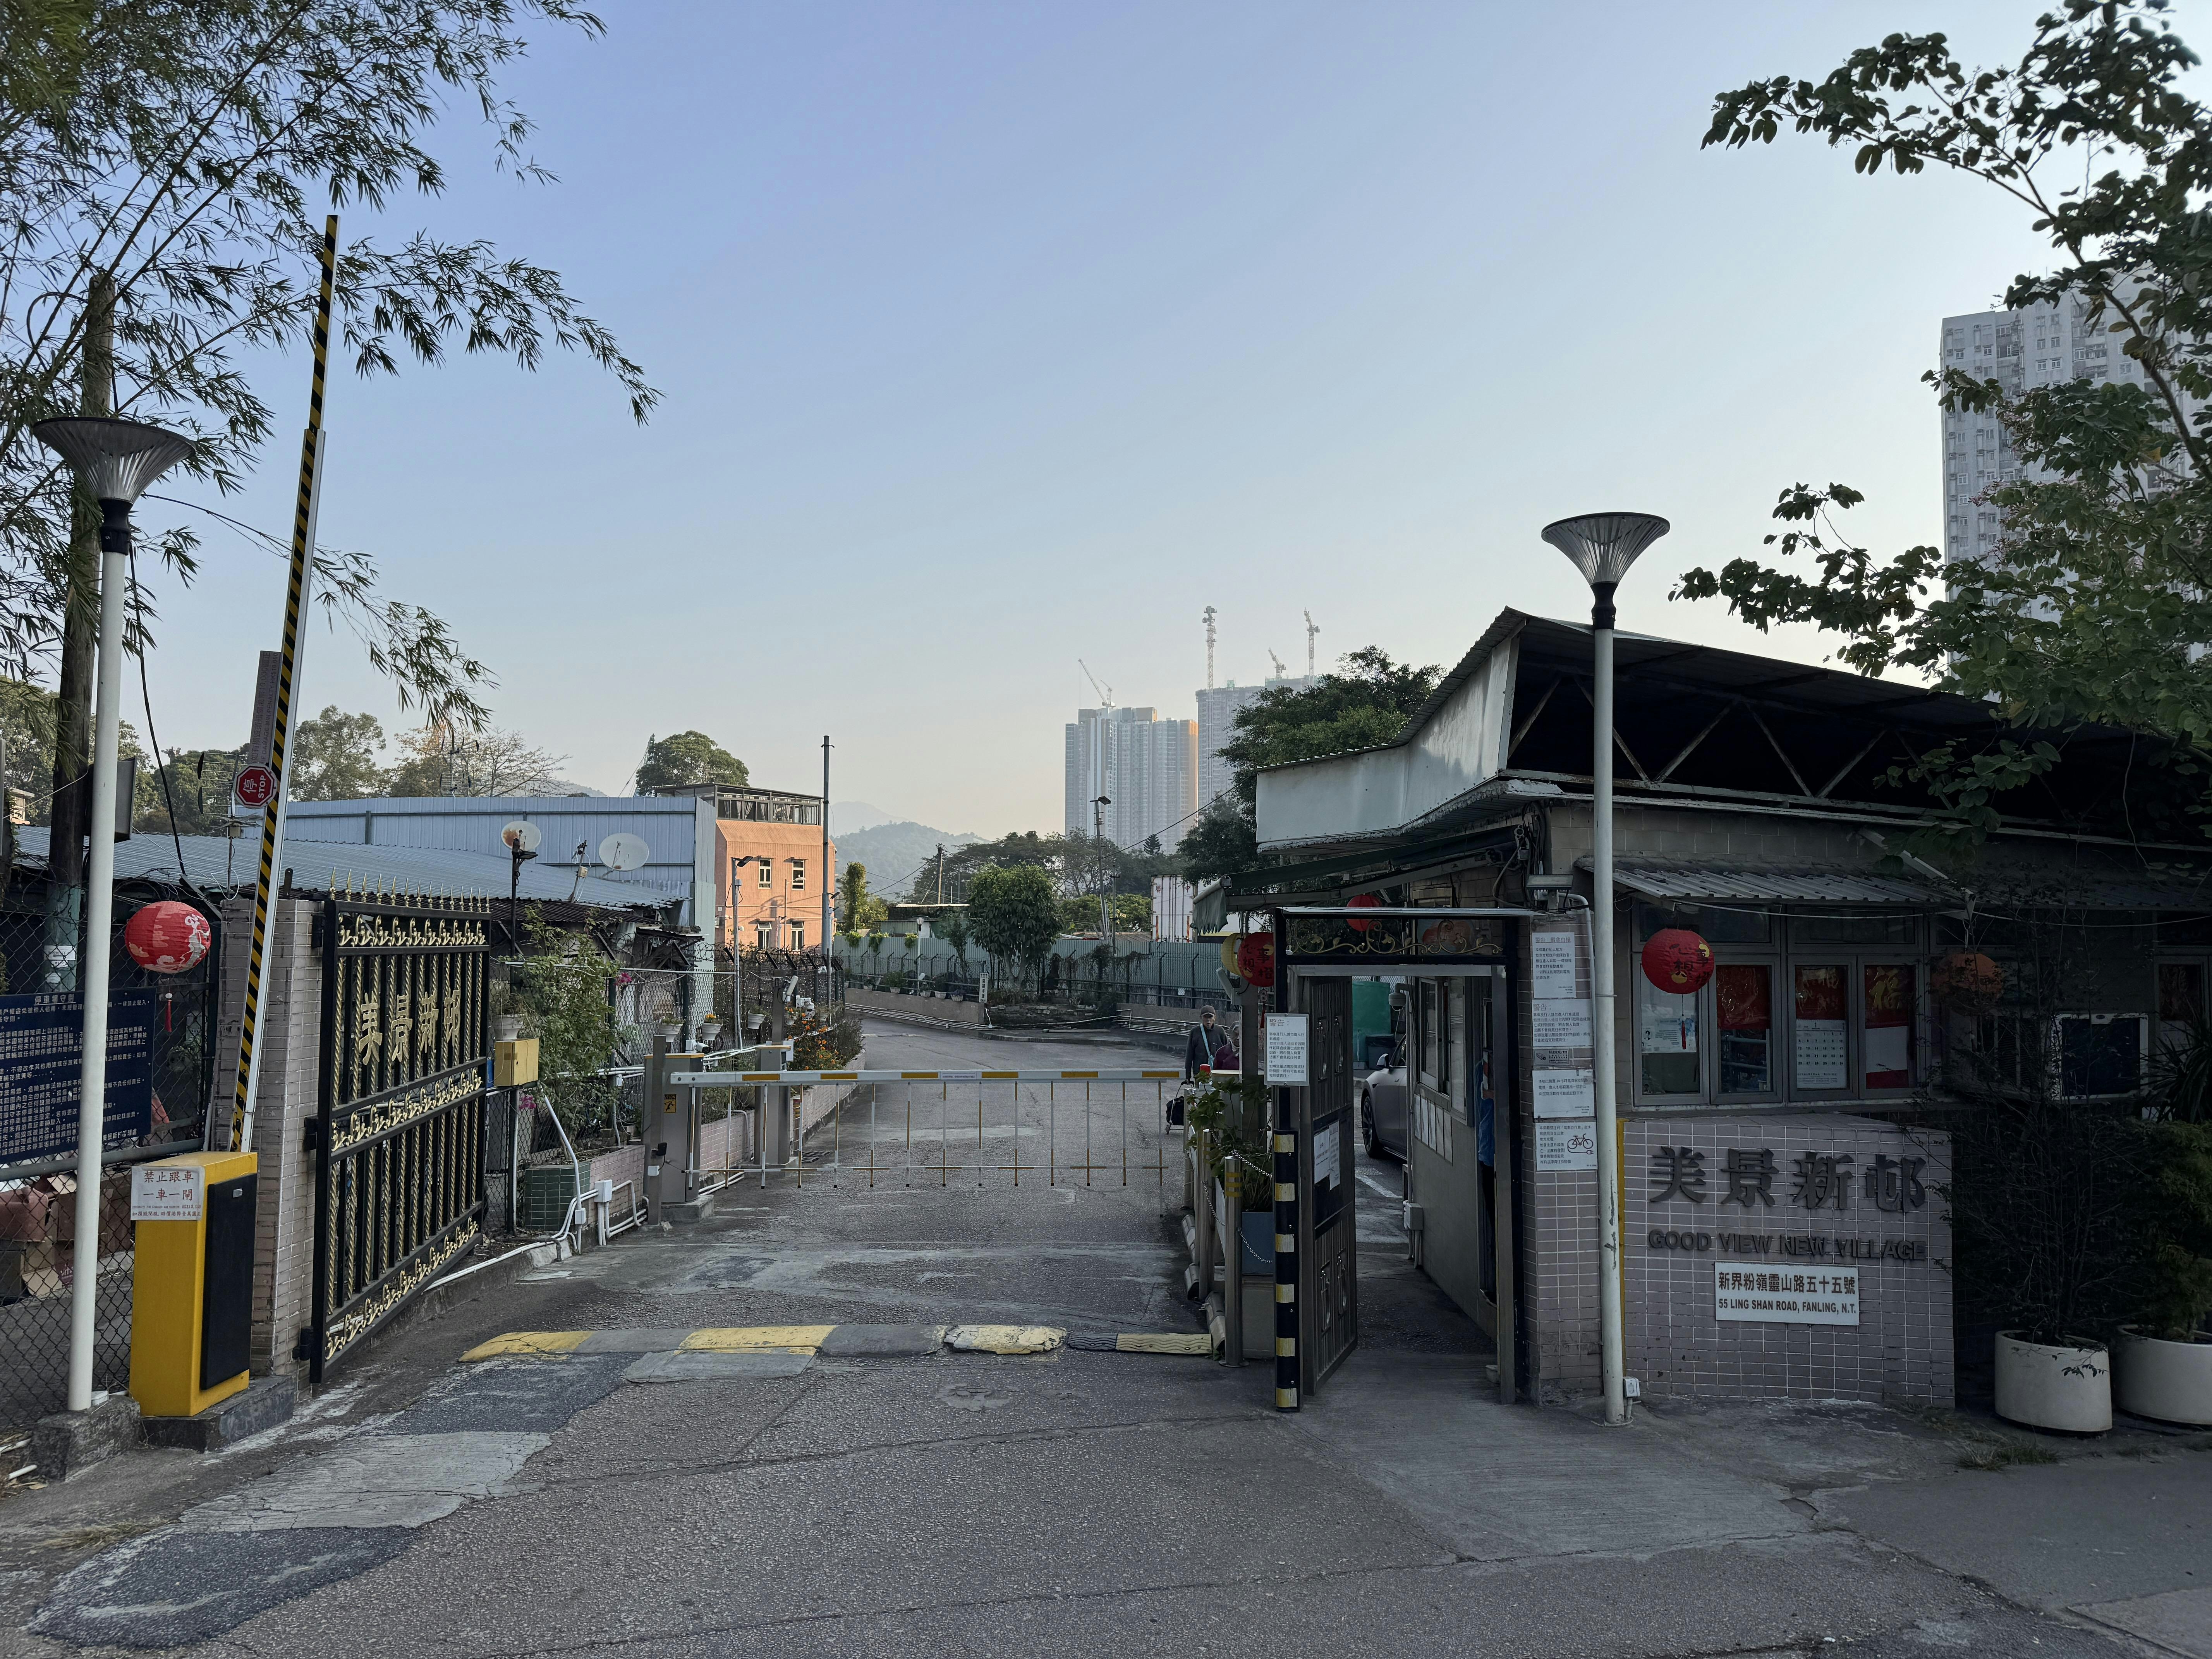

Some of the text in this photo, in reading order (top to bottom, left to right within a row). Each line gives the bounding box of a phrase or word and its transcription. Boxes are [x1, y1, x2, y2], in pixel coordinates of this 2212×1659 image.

[243, 779, 257, 793] 停
[258, 775, 266, 799] STOP
[1185, 884, 1191, 893] 中
[35, 994, 74, 1003] 停車場守則
[359, 989, 461, 1065] 美景新邨
[144, 1171, 194, 1183] 禁止跟車
[1649, 1146, 1927, 1212] 美景新邨
[143, 1188, 192, 1201] 一車一閘
[1649, 1229, 1927, 1261] GOOD VIEW NEW VILLAGE
[1719, 1272, 1855, 1295] 新界粉嶺靈山路五十五號
[1719, 1298, 1856, 1314] 55 LING SHAN ROAD, FANLING, N.T.
